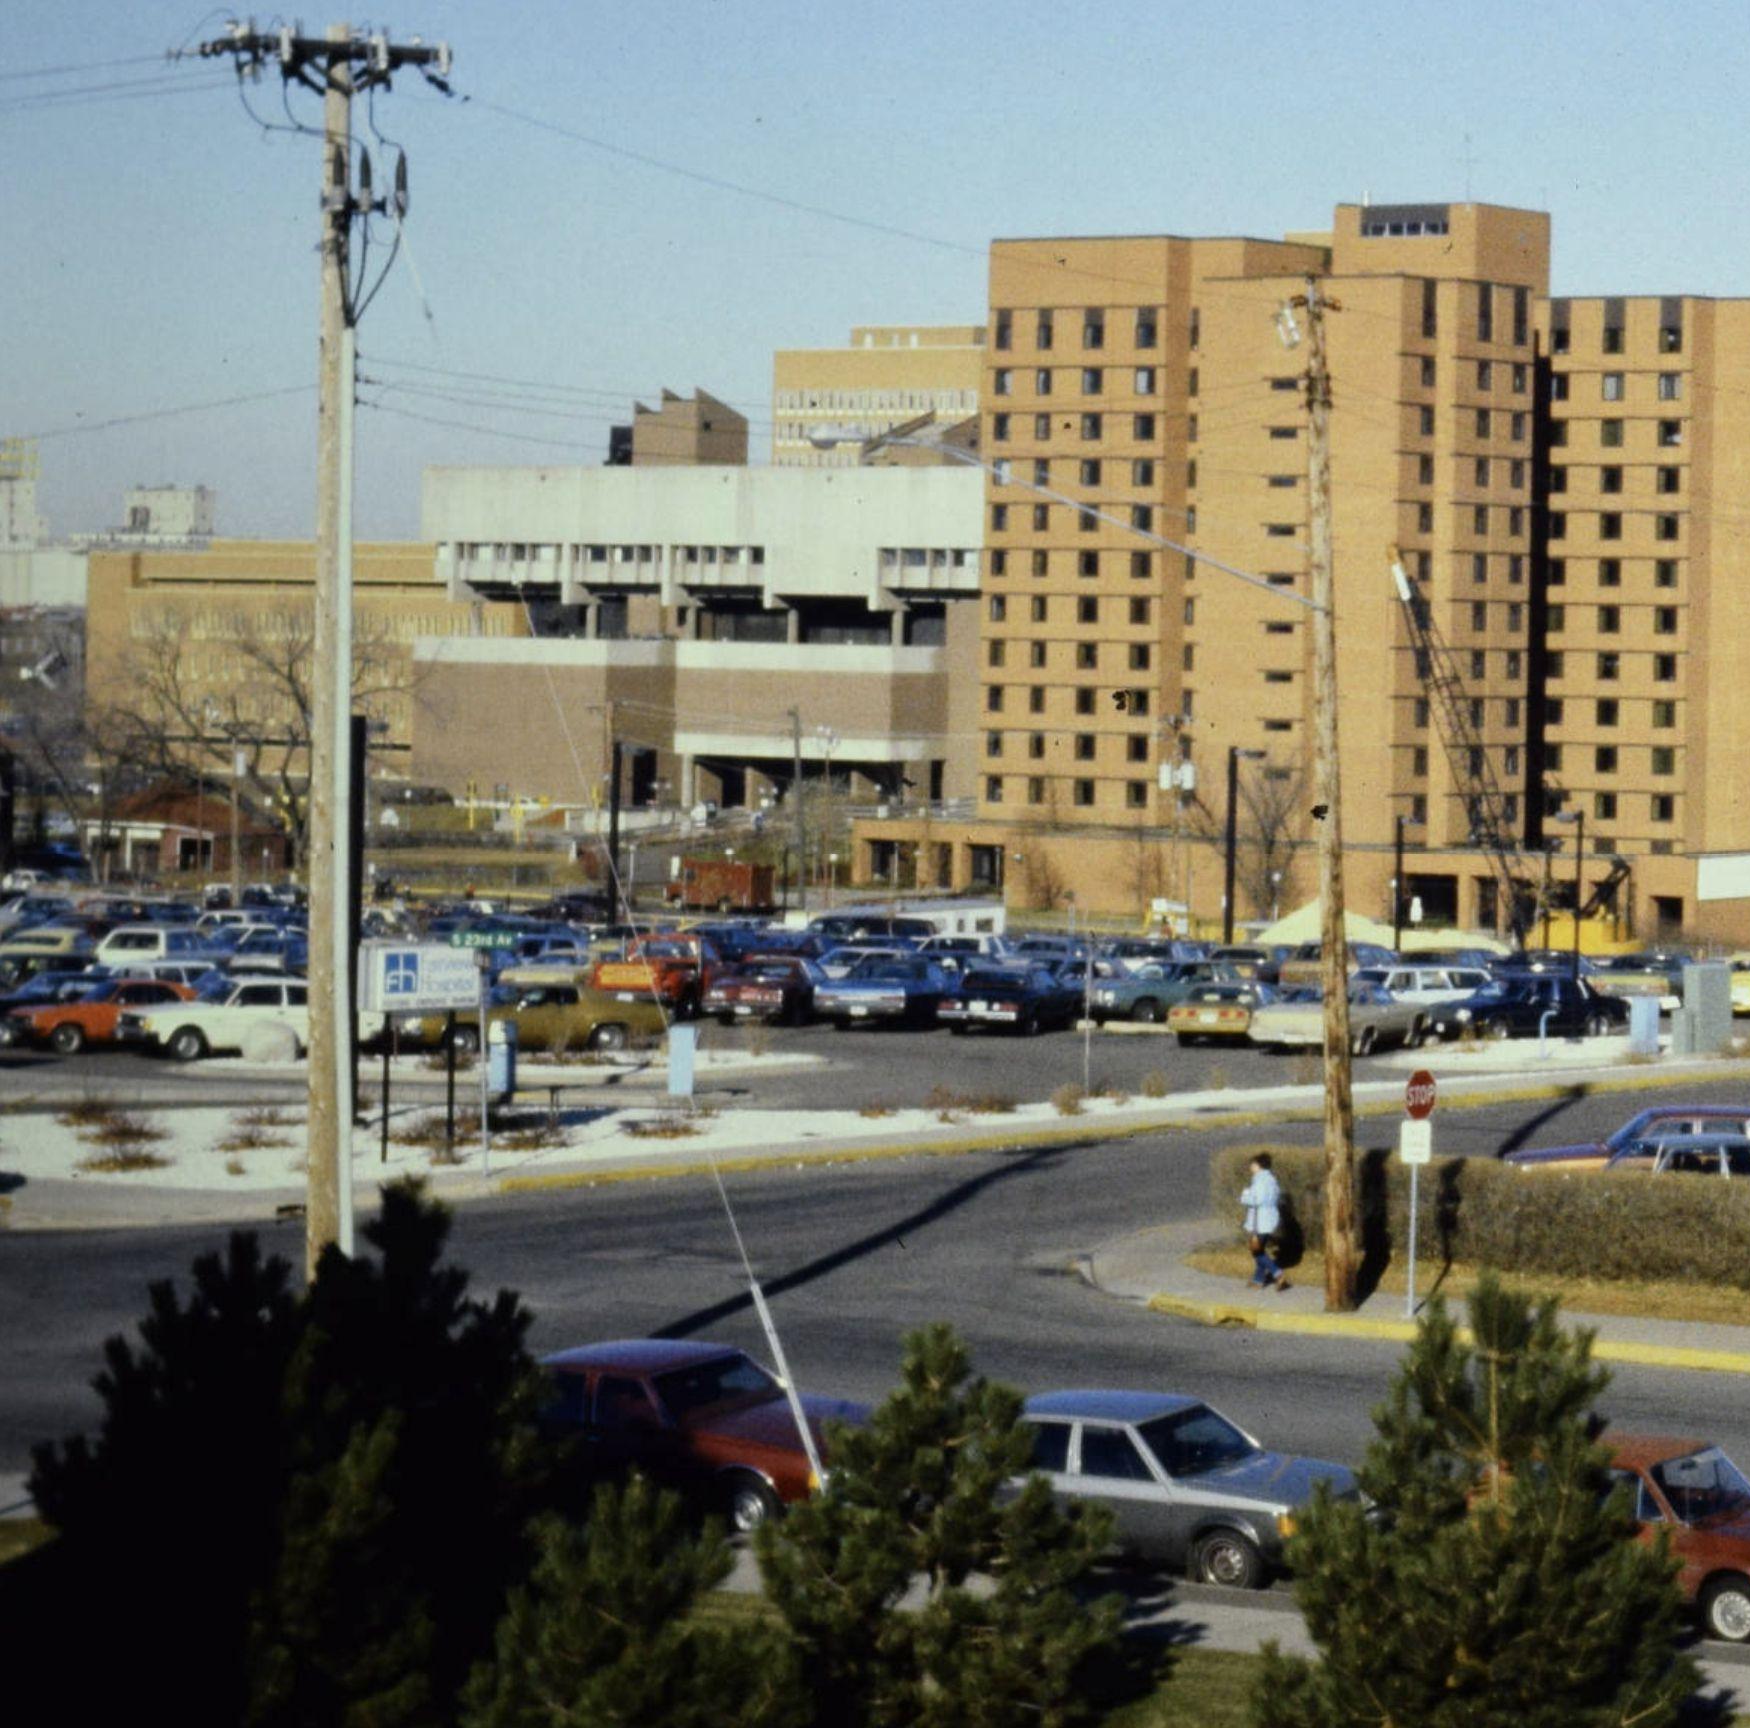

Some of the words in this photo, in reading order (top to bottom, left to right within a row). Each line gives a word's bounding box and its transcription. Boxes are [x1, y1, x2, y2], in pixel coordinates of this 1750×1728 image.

[452, 933, 460, 946] S
[464, 933, 493, 946] 23rd
[497, 933, 512, 946] Av
[1407, 1084, 1435, 1106] STOP
